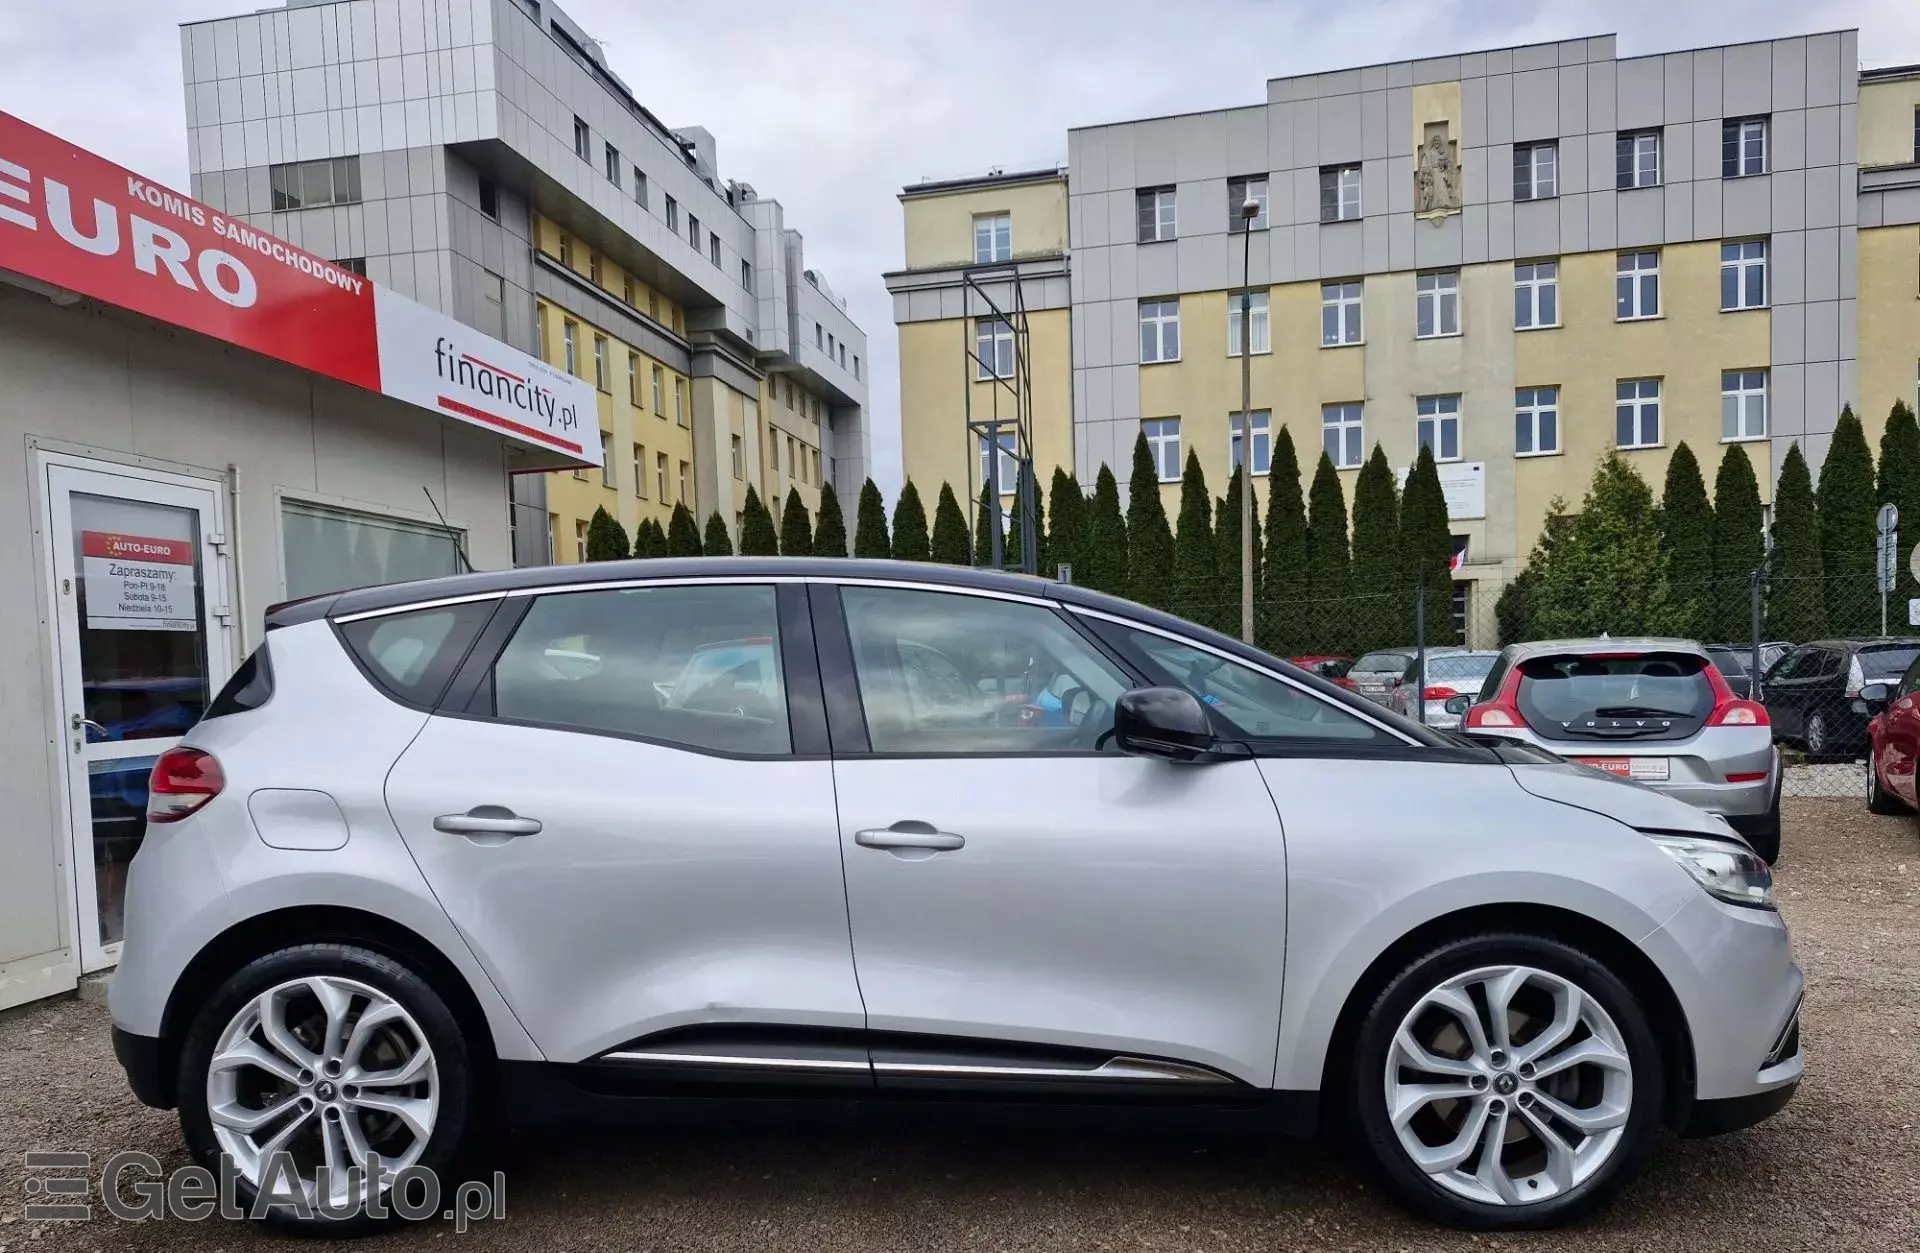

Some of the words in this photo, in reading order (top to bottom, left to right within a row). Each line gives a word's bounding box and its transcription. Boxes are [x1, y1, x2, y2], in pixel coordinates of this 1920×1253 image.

[128, 176, 206, 227] KOMIS
[213, 215, 363, 296] SAMOCHODOWY
[435, 337, 577, 431] financity.pl
[113, 541, 171, 556] AUTO-EURO
[109, 563, 177, 583] Zapraszamy:
[123, 591, 150, 602] Sobota
